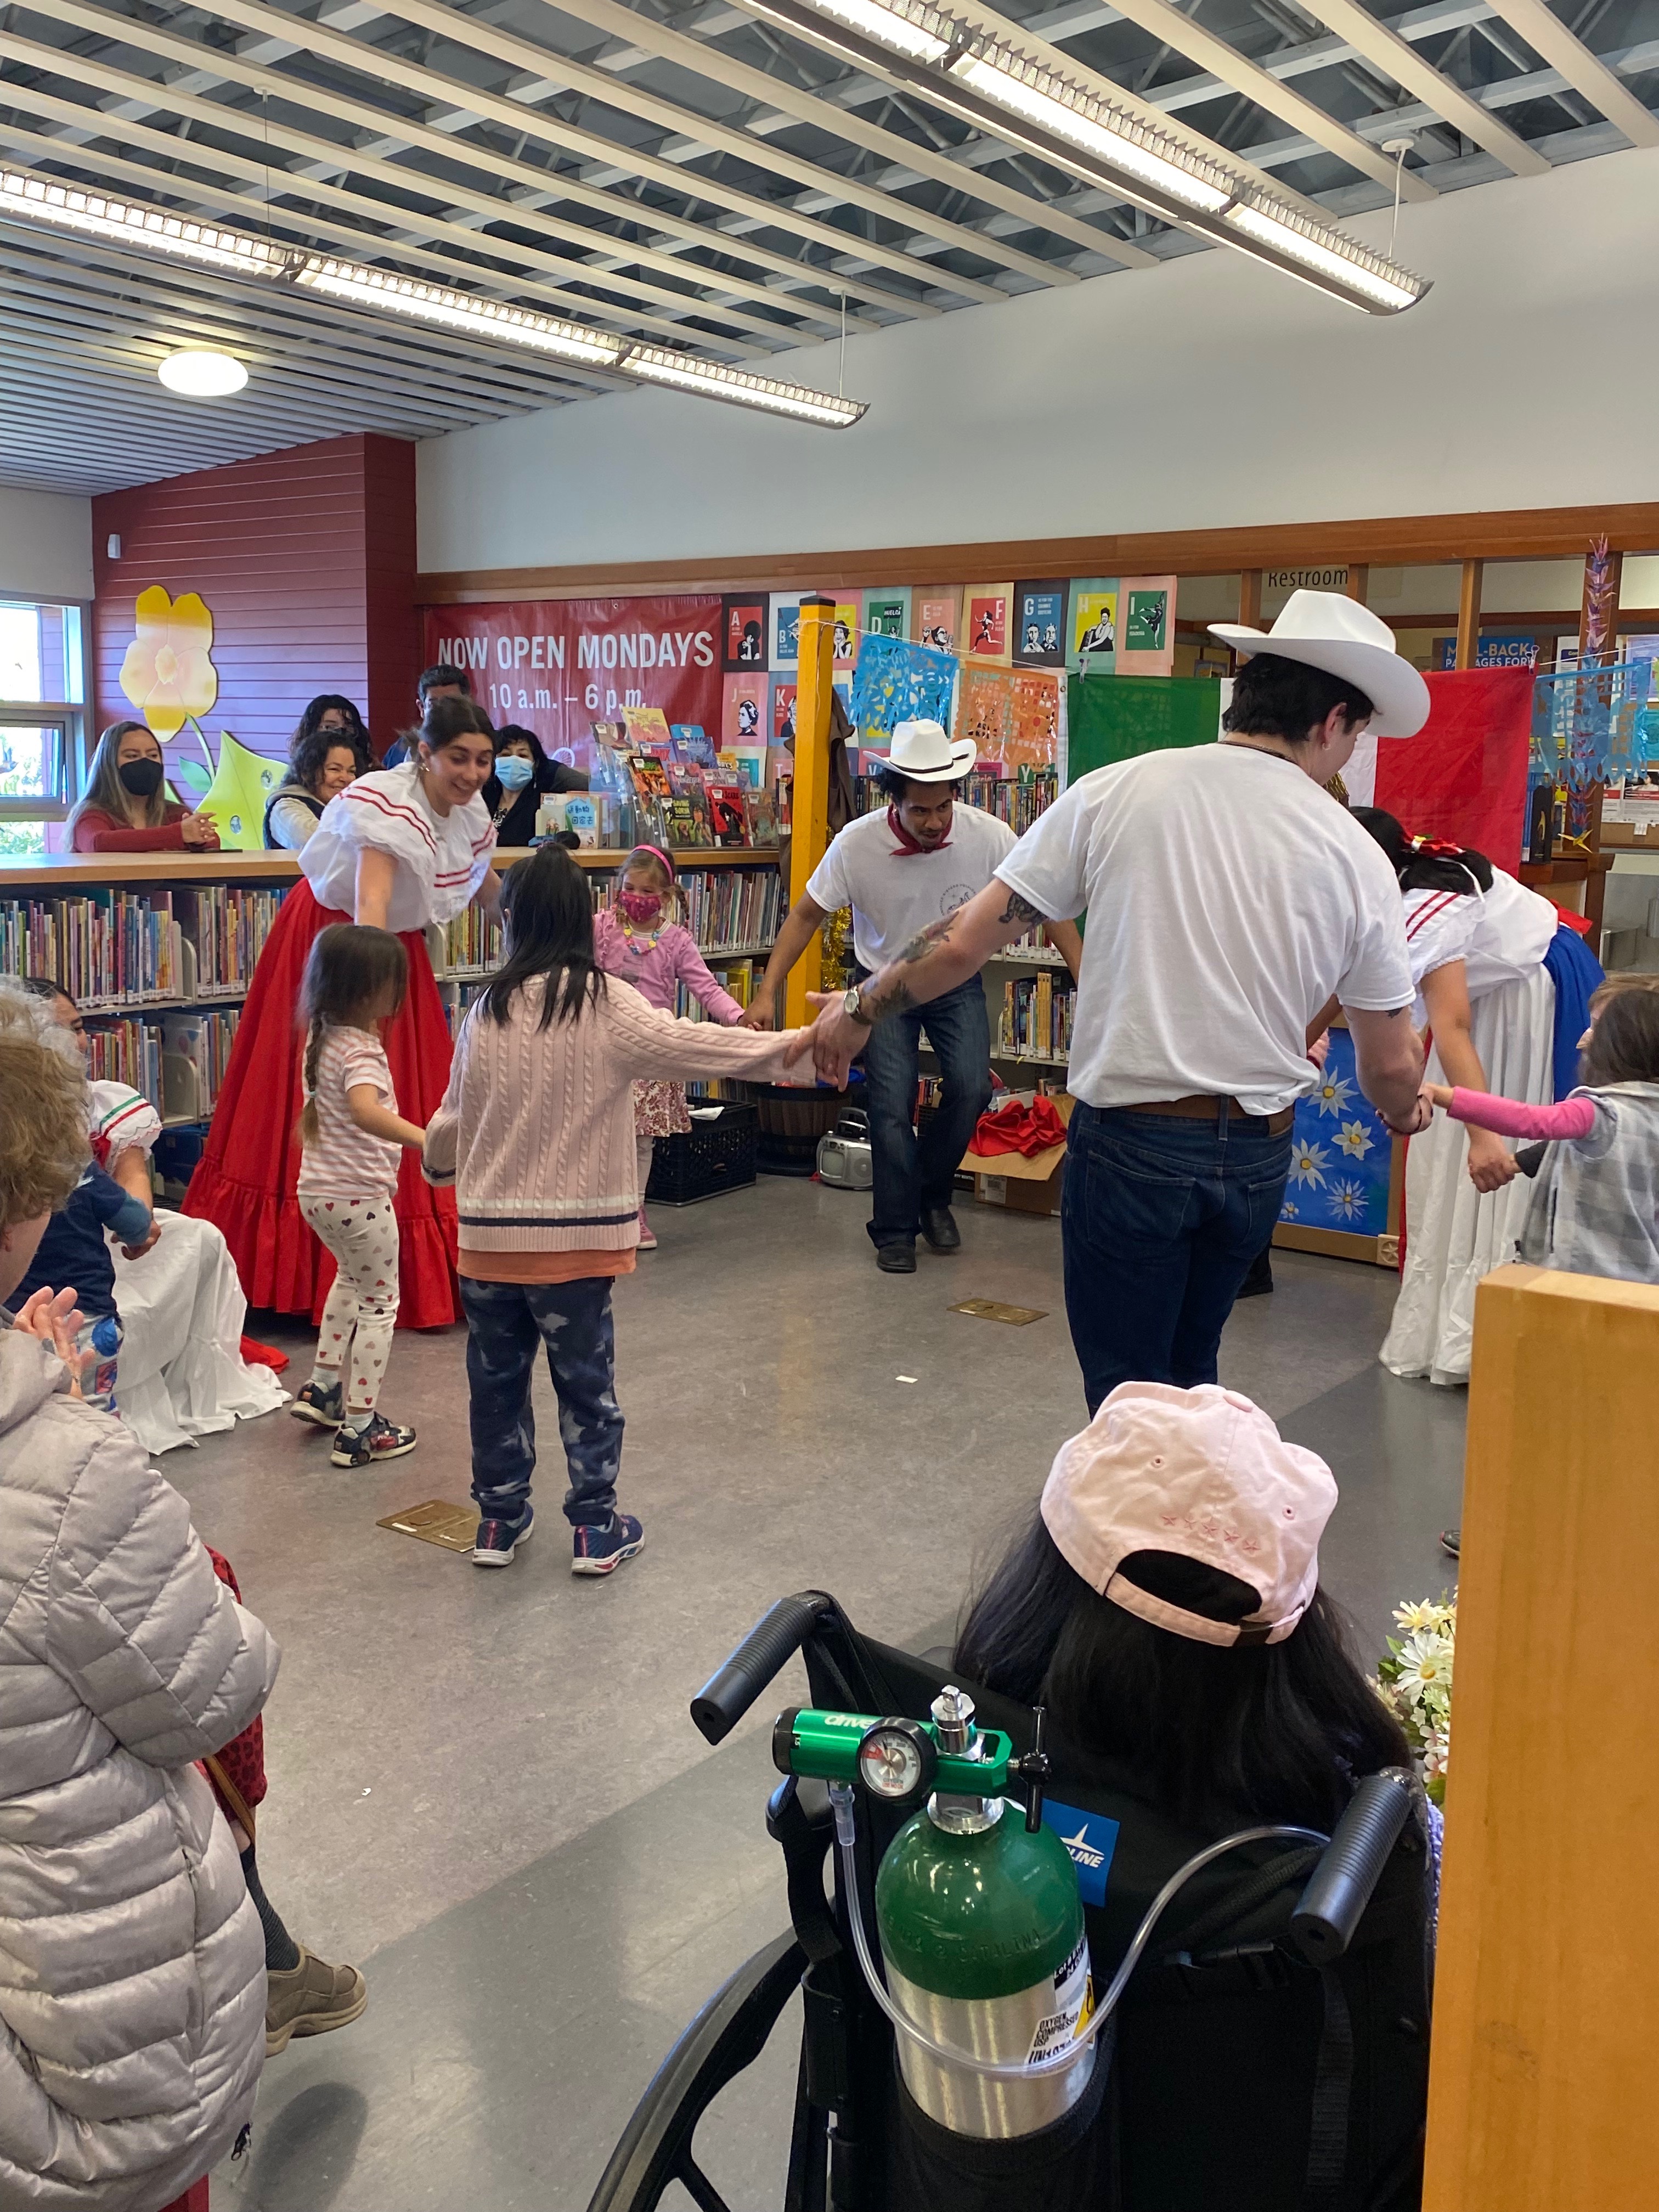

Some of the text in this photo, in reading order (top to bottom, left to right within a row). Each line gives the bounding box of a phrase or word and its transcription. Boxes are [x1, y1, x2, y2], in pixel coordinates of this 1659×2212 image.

[1268, 569, 1348, 588] Restroom
[923, 605, 931, 620] E
[995, 600, 1003, 619] F
[1025, 598, 1034, 616] G
[1079, 597, 1088, 613] H
[731, 611, 740, 626] A
[871, 617, 882, 634] D
[779, 630, 786, 643] B
[438, 631, 714, 669] NOW OPEN MONDAYS
[1447, 643, 1530, 657] ML-BACK
[1446, 657, 1502, 668] PAAGES
[489, 683, 512, 709] 10
[518, 689, 557, 709] a.m.
[585, 684, 599, 709] 6
[606, 689, 646, 715] p.m.
[731, 688, 737, 702] J
[776, 689, 786, 706] K
[775, 764, 783, 778] T
[868, 765, 877, 775] V
[1021, 765, 1030, 783] Y
[825, 1714, 875, 1729] drive
[1040, 2012, 1067, 2030] OXYGEN
